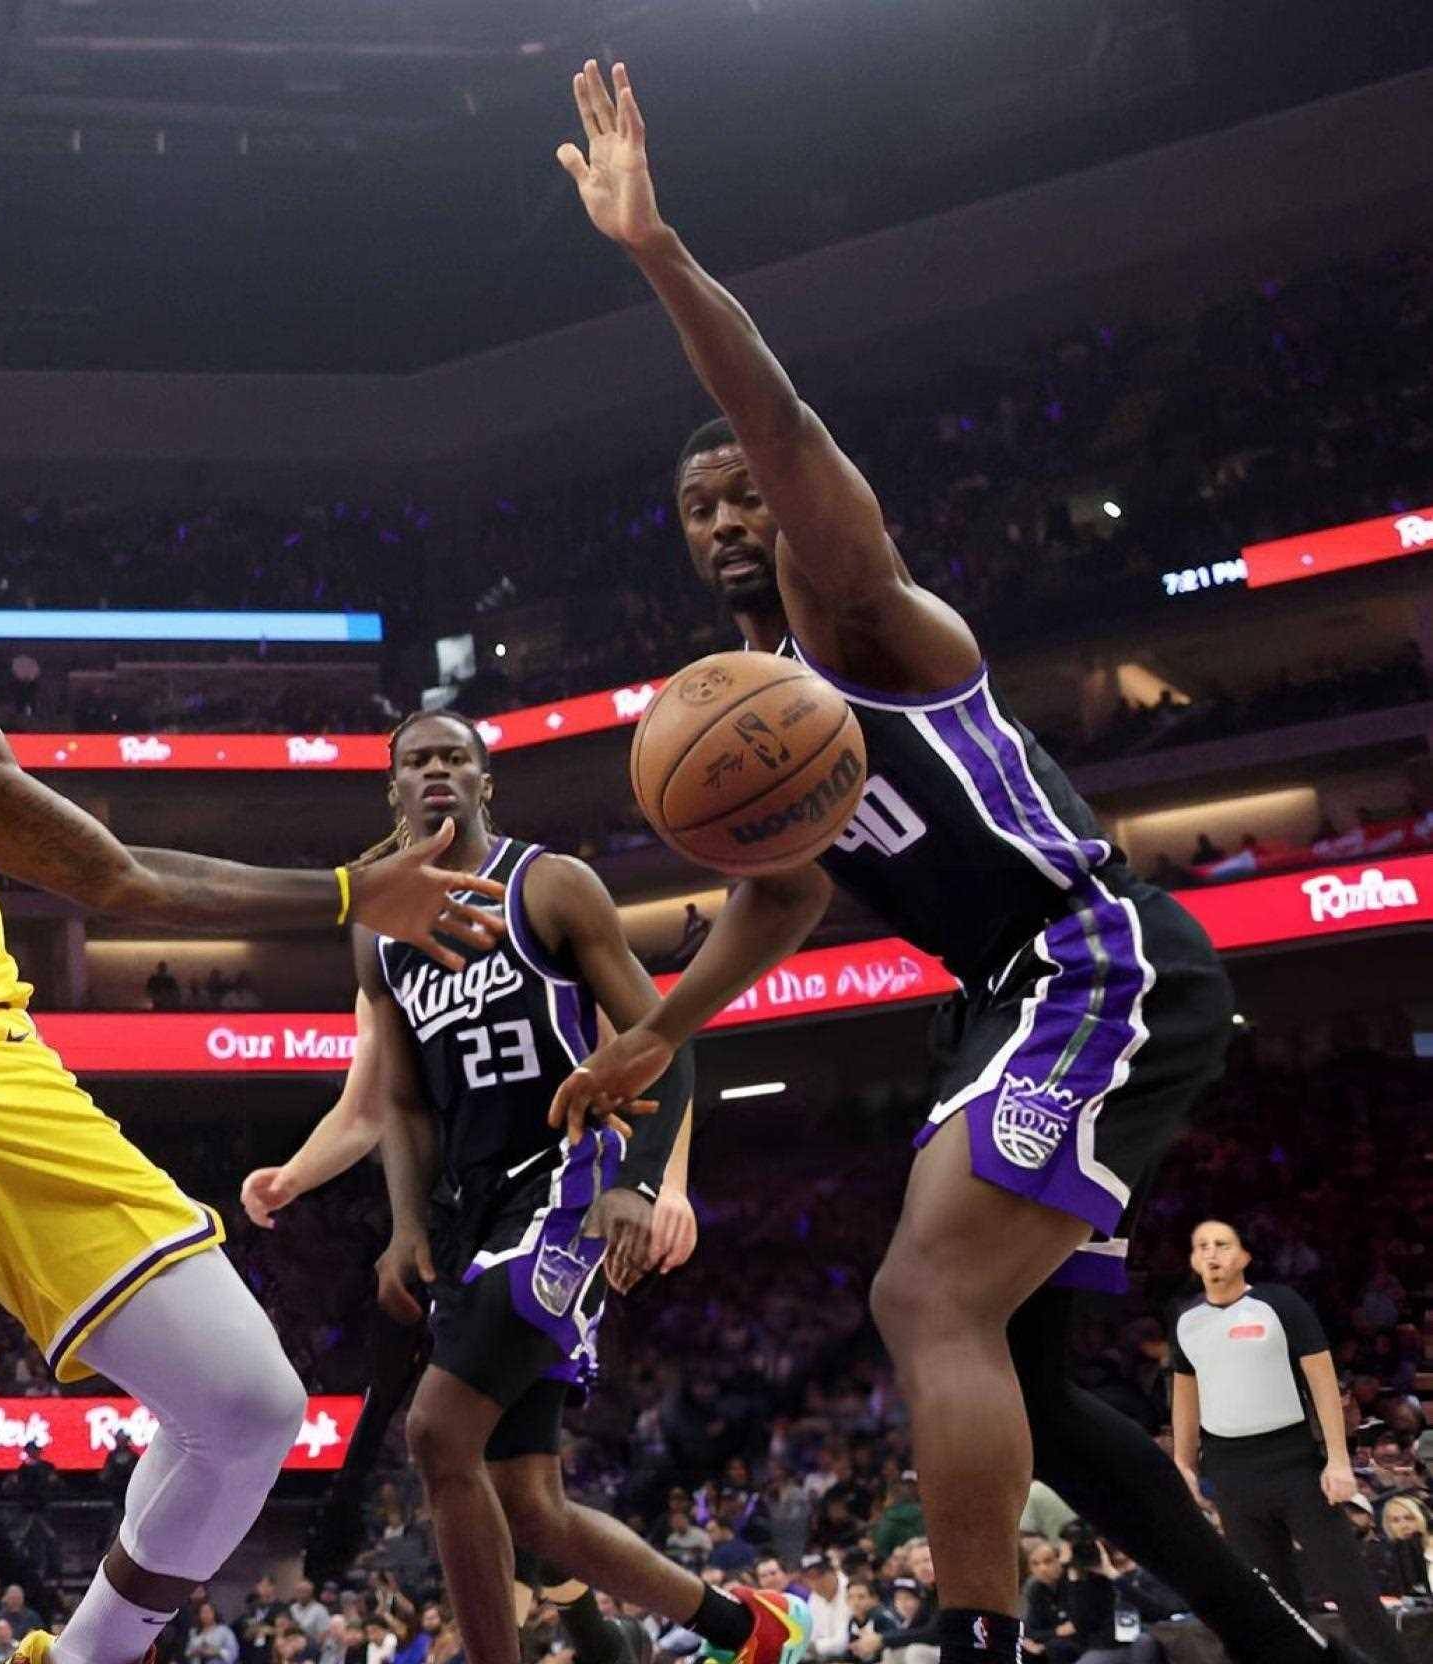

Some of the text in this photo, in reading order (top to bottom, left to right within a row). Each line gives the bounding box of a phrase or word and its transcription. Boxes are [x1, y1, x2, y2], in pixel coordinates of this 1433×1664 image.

[392, 951, 524, 1043] Kings
[207, 1026, 276, 1060] Our
[457, 1018, 542, 1089] 23
